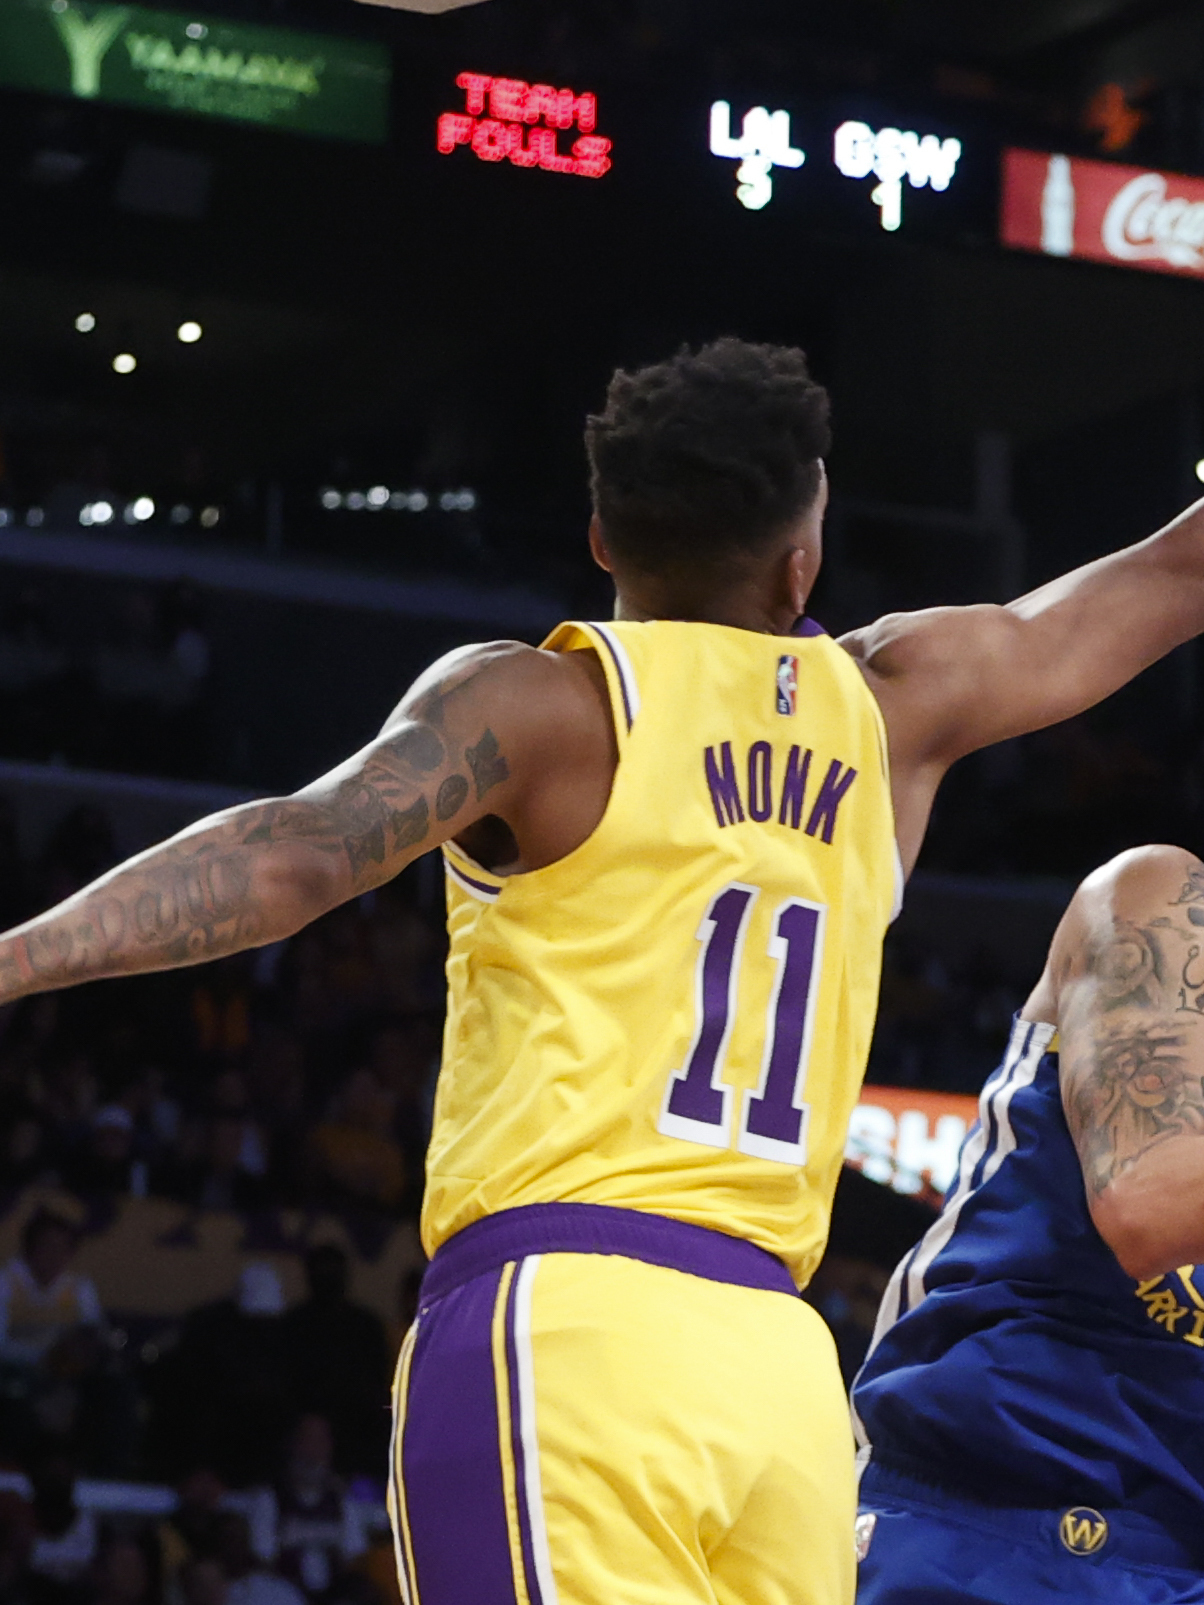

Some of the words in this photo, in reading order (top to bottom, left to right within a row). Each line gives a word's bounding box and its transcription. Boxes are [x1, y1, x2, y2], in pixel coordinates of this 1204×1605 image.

[437, 112, 612, 178] FOULS
[456, 72, 596, 132] TEAM
[709, 100, 805, 167] LAL
[834, 120, 961, 191] GSW
[704, 740, 858, 845] MONK
[657, 880, 828, 1166] 11
